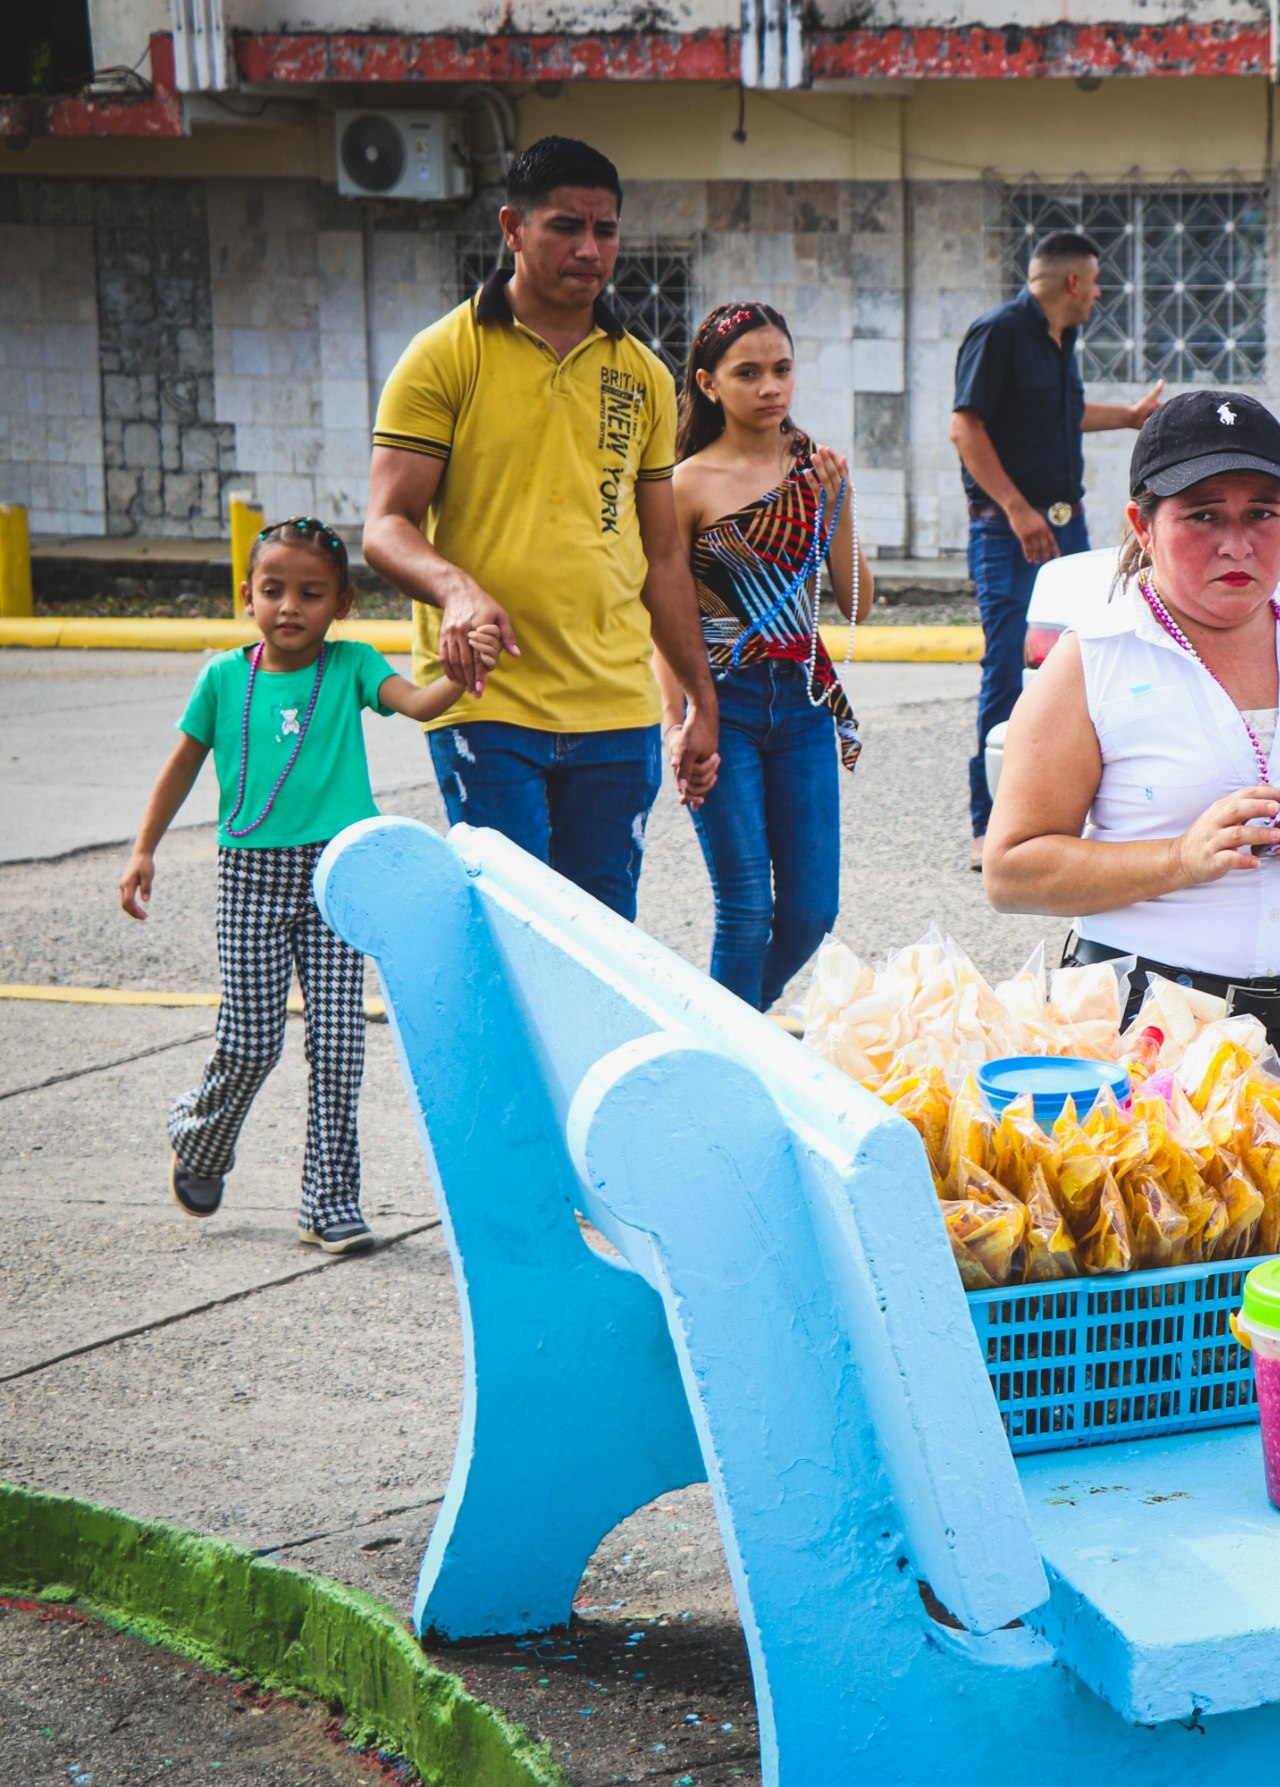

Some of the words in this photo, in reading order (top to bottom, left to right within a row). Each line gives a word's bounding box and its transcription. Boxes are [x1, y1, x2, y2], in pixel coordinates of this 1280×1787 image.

[601, 366, 647, 401] BRITIH
[607, 397, 632, 459] NEW
[600, 467, 624, 535] YORK
